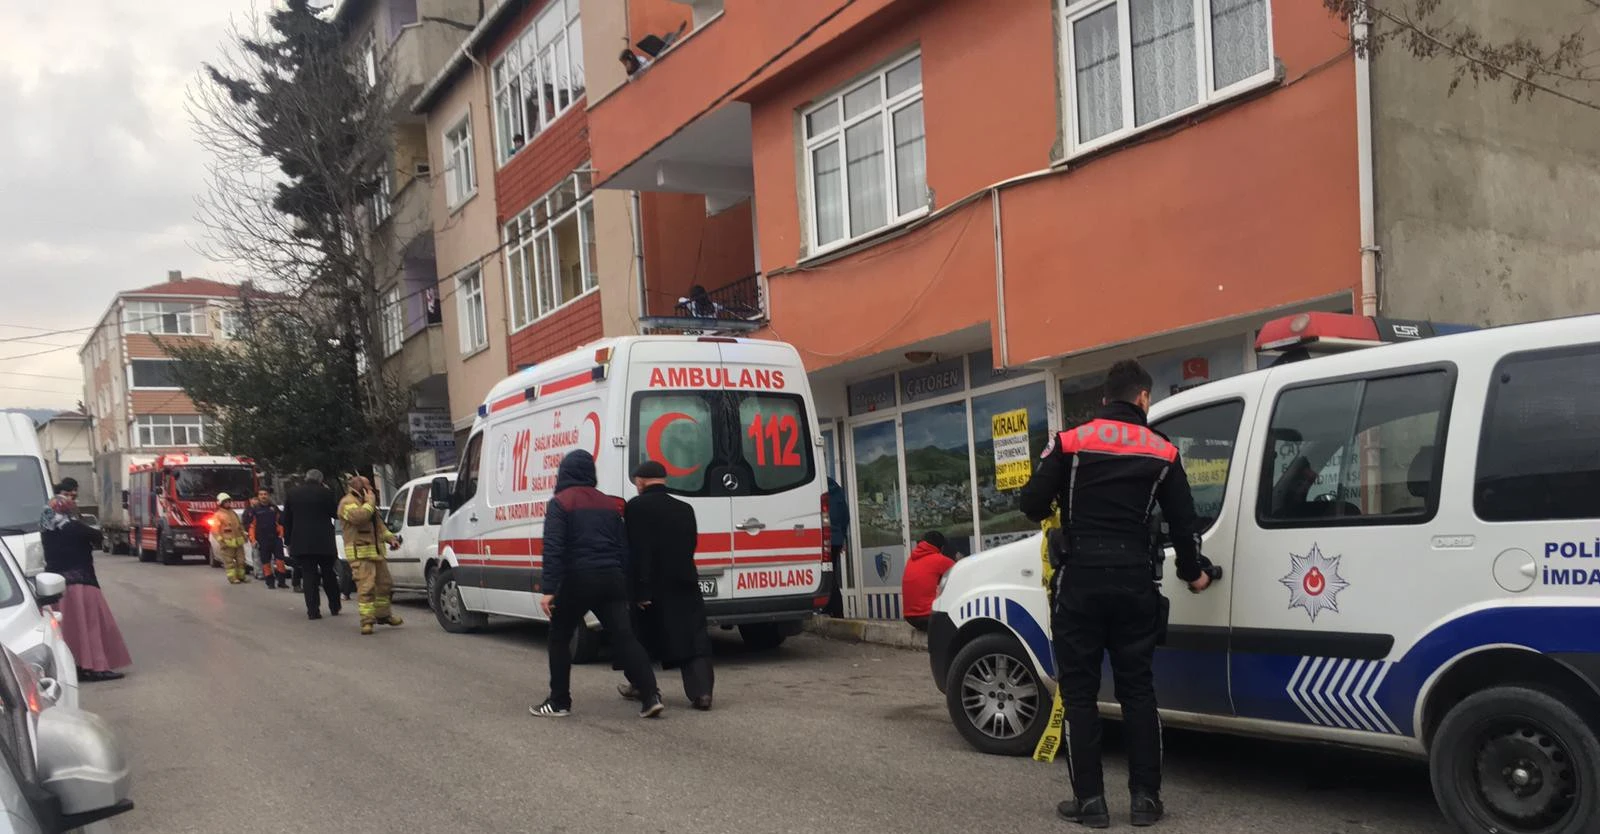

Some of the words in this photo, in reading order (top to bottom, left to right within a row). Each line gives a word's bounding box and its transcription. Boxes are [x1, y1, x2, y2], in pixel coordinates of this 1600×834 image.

[648, 367, 785, 389] AMBULANS
[747, 411, 801, 466] 112
[512, 428, 531, 492] 112
[1544, 537, 1600, 558] POLİ
[737, 569, 814, 590] AMBULANS
[1543, 565, 1600, 585] İMDA
